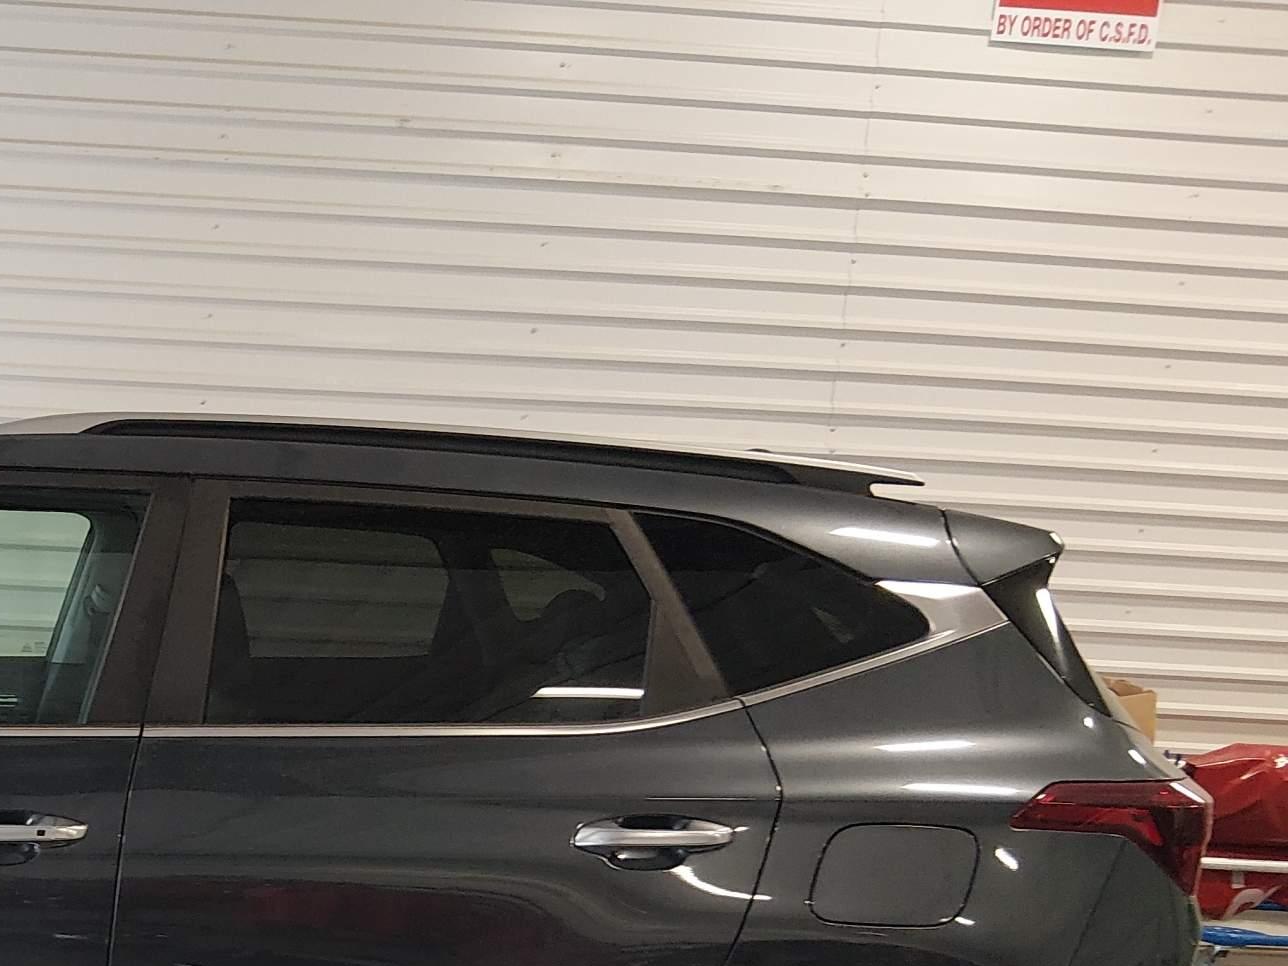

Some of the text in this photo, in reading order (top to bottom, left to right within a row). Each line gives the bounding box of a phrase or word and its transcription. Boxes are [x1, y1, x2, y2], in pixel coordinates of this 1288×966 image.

[996, 14, 1018, 36] BY
[1021, 15, 1072, 40] ORDER
[1076, 19, 1096, 41] OF
